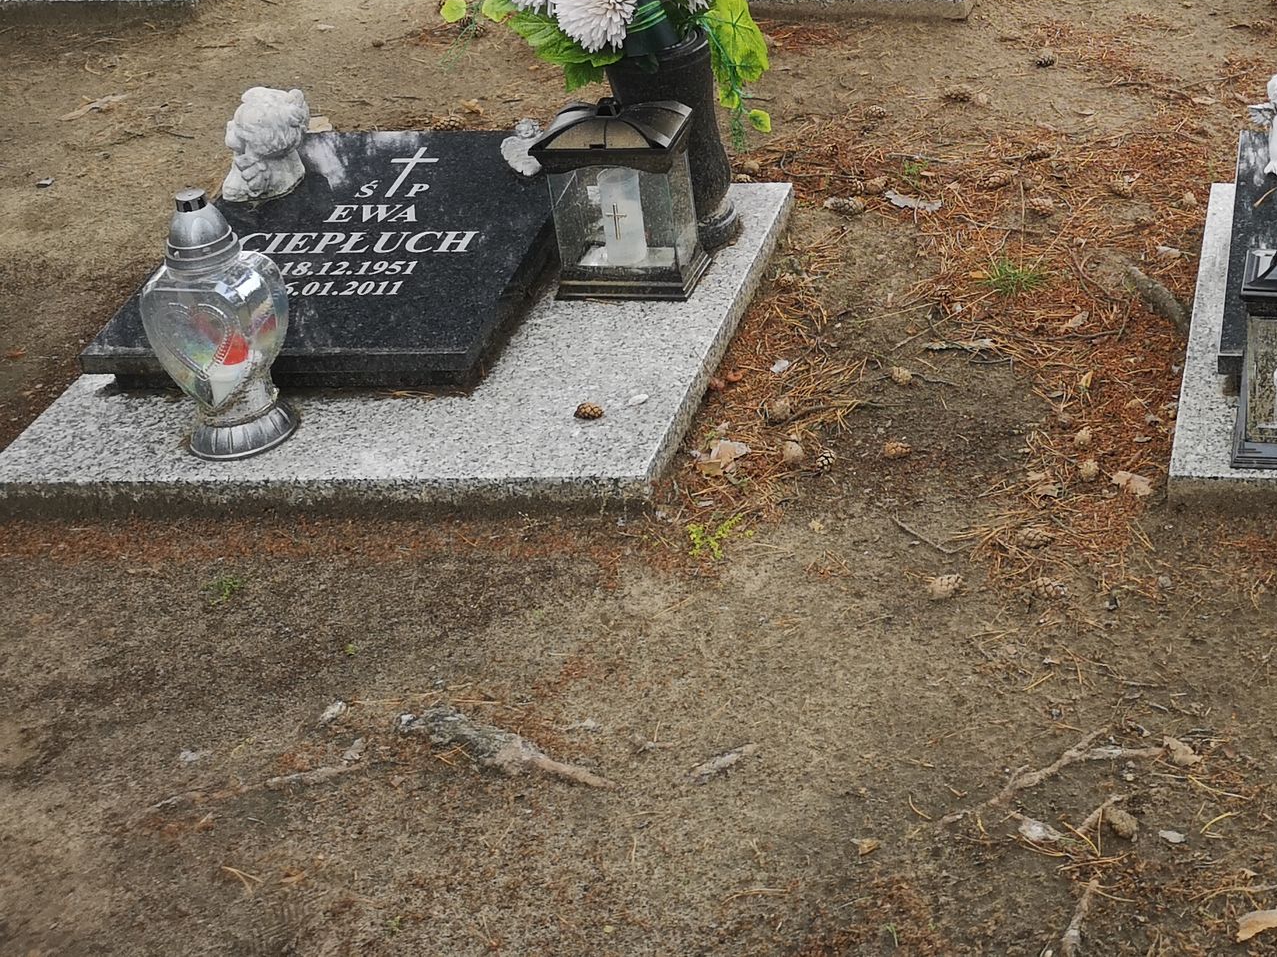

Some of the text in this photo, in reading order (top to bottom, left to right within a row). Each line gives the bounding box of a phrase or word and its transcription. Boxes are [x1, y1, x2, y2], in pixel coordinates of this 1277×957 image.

[355, 180, 430, 198] Ś P
[323, 204, 418, 223] EWA
[239, 230, 480, 254] CIEPŁUCH
[281, 261, 418, 276] 18.12.1951
